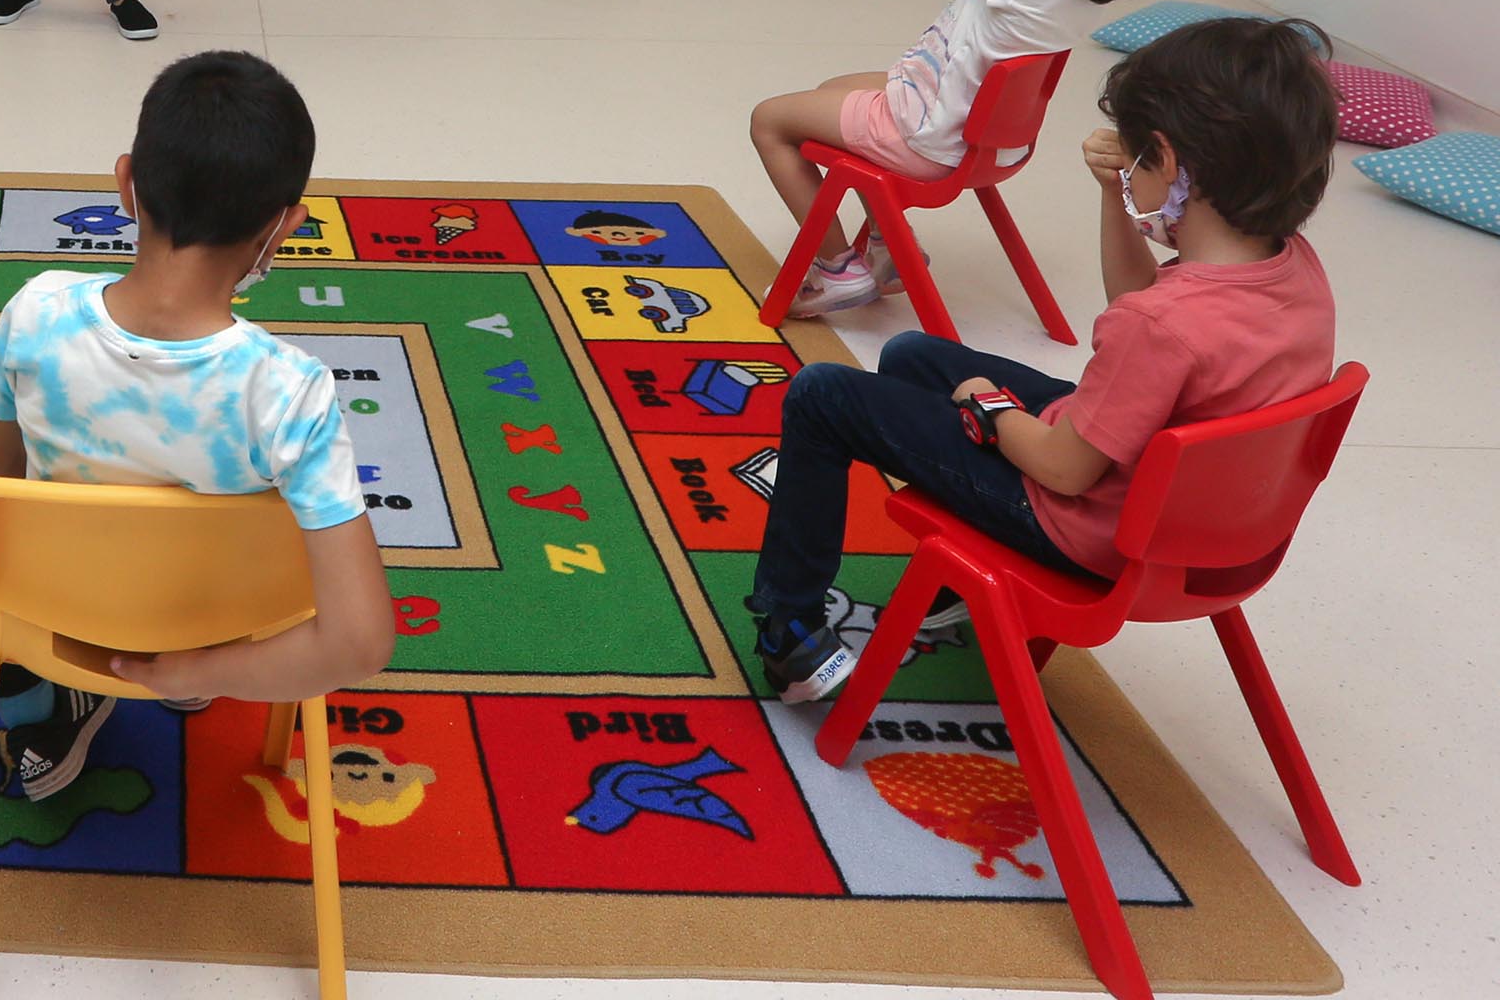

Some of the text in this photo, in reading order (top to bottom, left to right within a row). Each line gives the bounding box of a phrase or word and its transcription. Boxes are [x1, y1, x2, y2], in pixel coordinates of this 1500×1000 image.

[56, 237, 134, 251] Fish
[396, 250, 506, 260] cream
[596, 250, 666, 265] Boy
[581, 287, 614, 317] Car
[332, 368, 380, 381] en
[624, 369, 671, 407] Bed
[670, 457, 731, 523] Book
[565, 711, 697, 744] Bird
[20, 759, 53, 780] adidas
